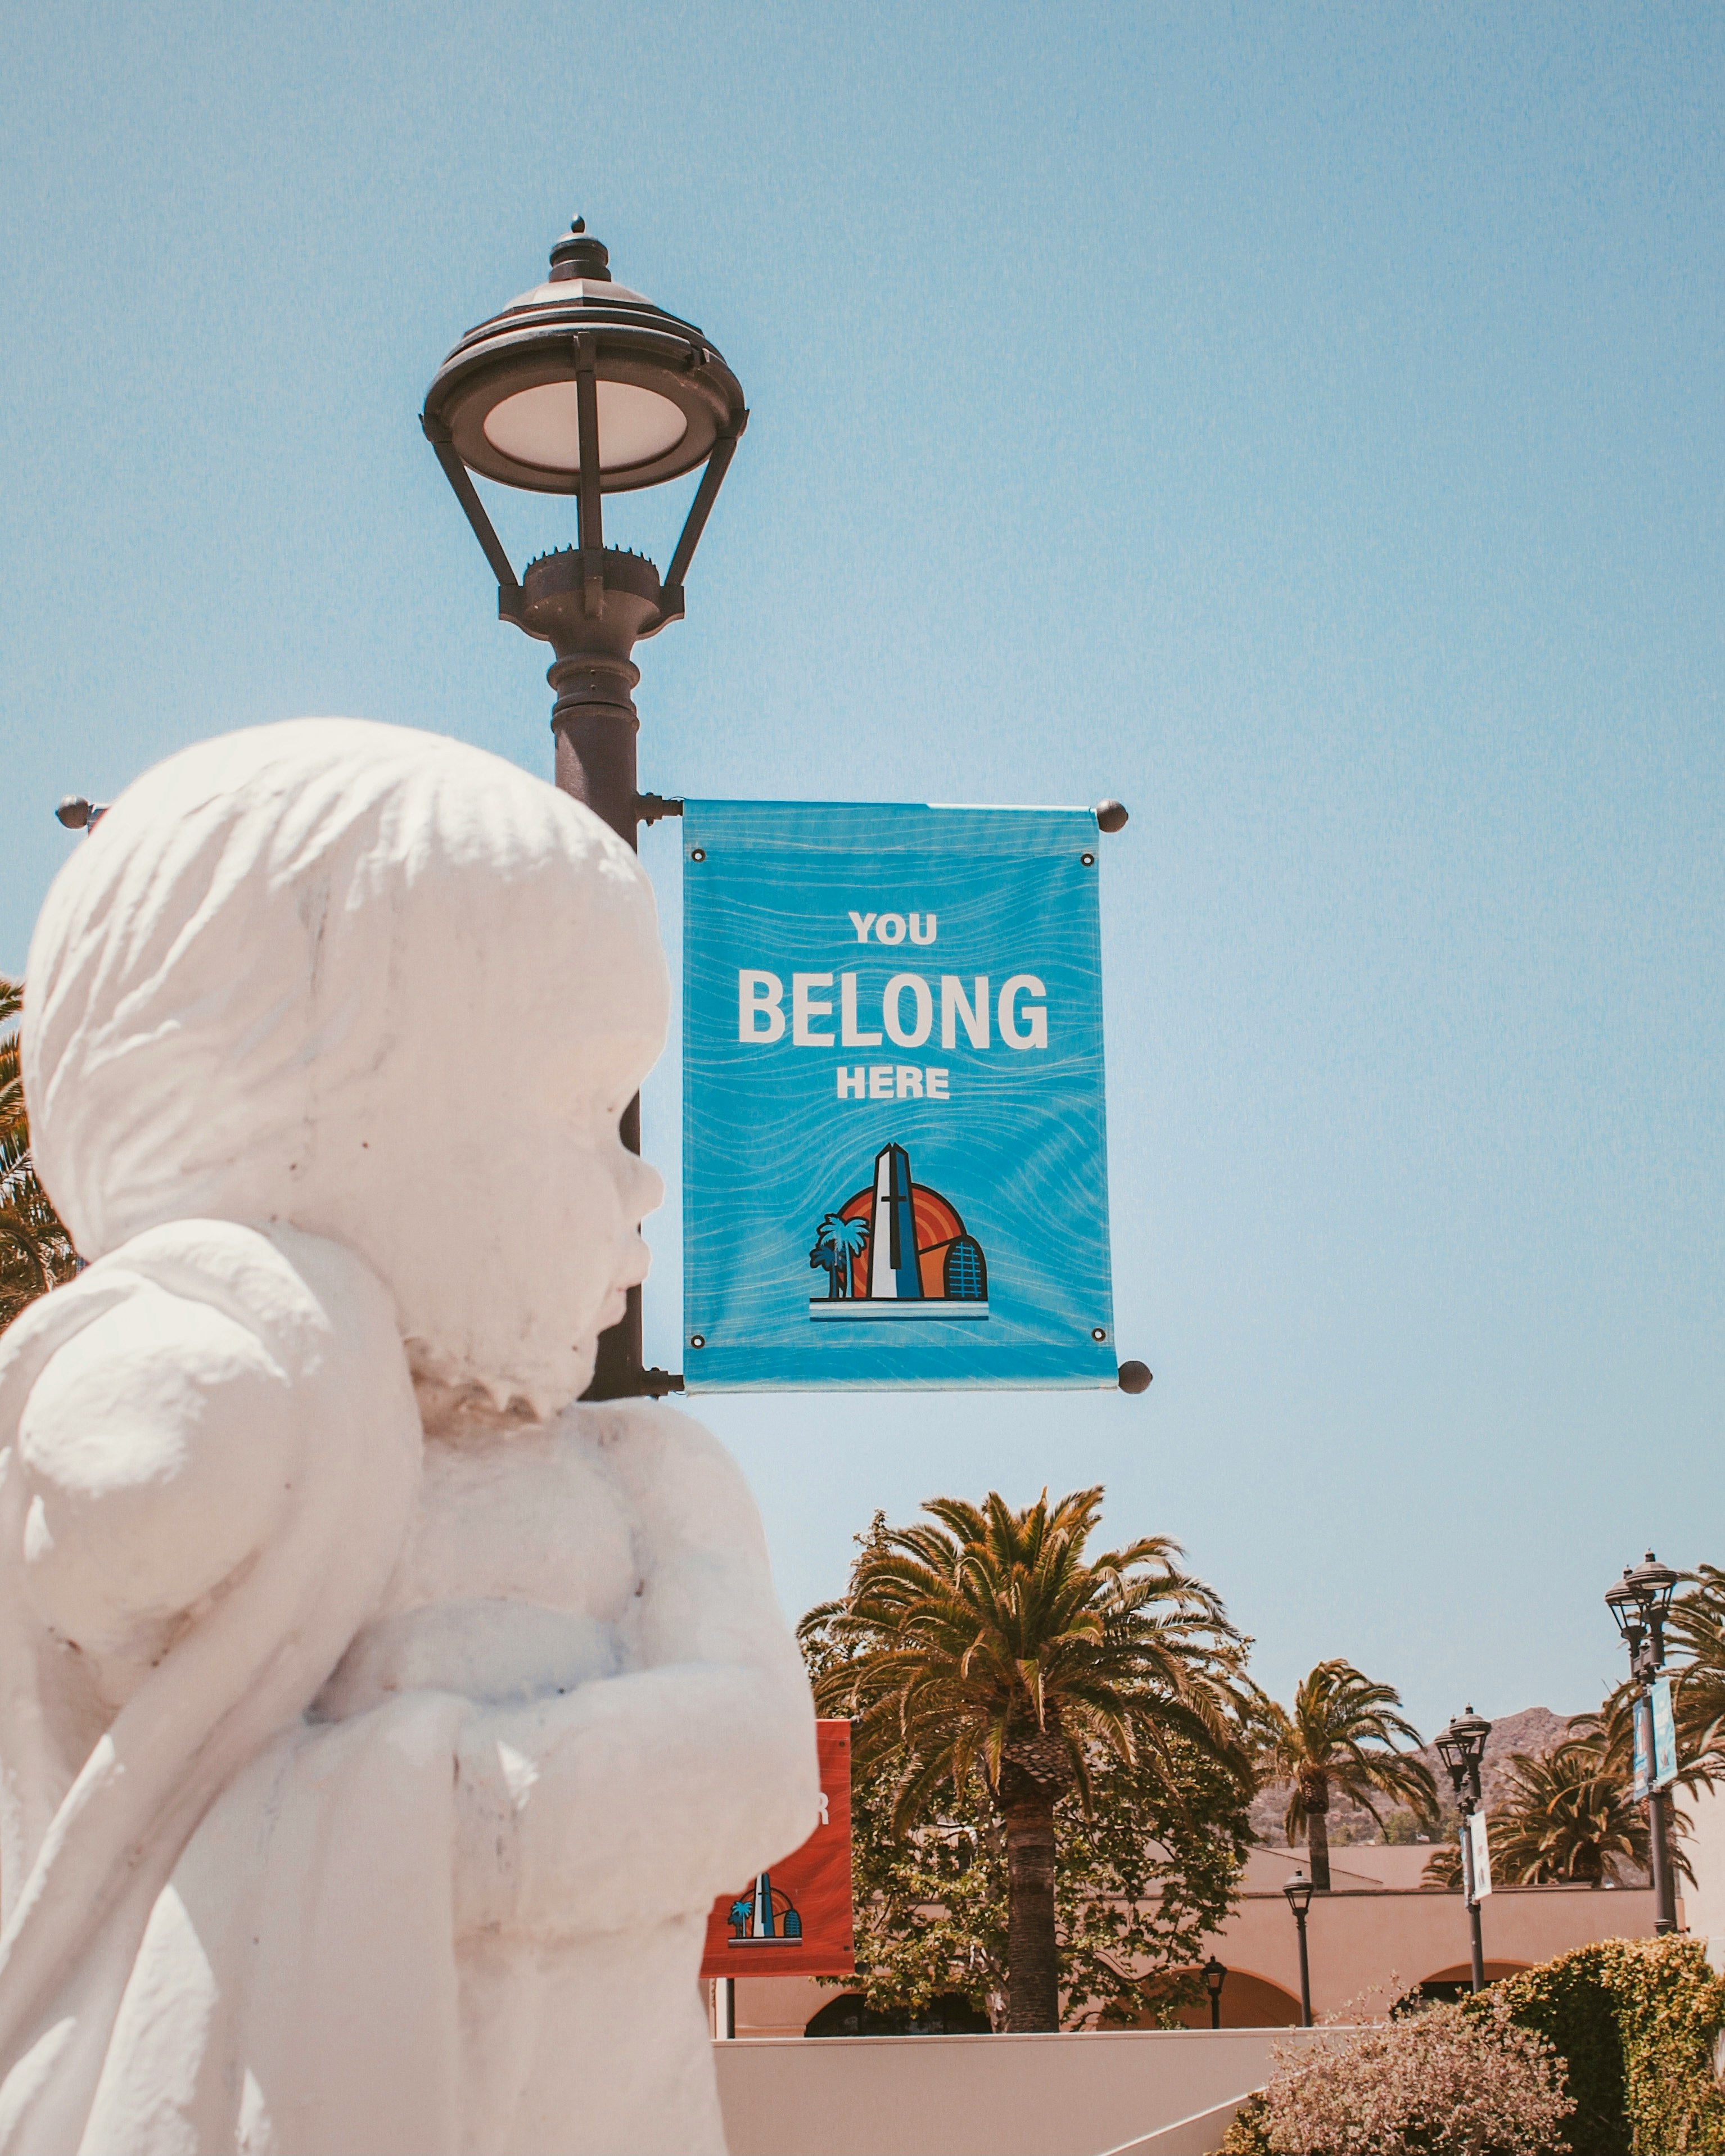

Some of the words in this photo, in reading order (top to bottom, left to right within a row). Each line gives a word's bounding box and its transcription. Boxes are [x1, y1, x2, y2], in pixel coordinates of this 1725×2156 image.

[848, 911, 937, 946] YOU
[739, 969, 1048, 1050] BELONG
[837, 1065, 951, 1100] HERE
